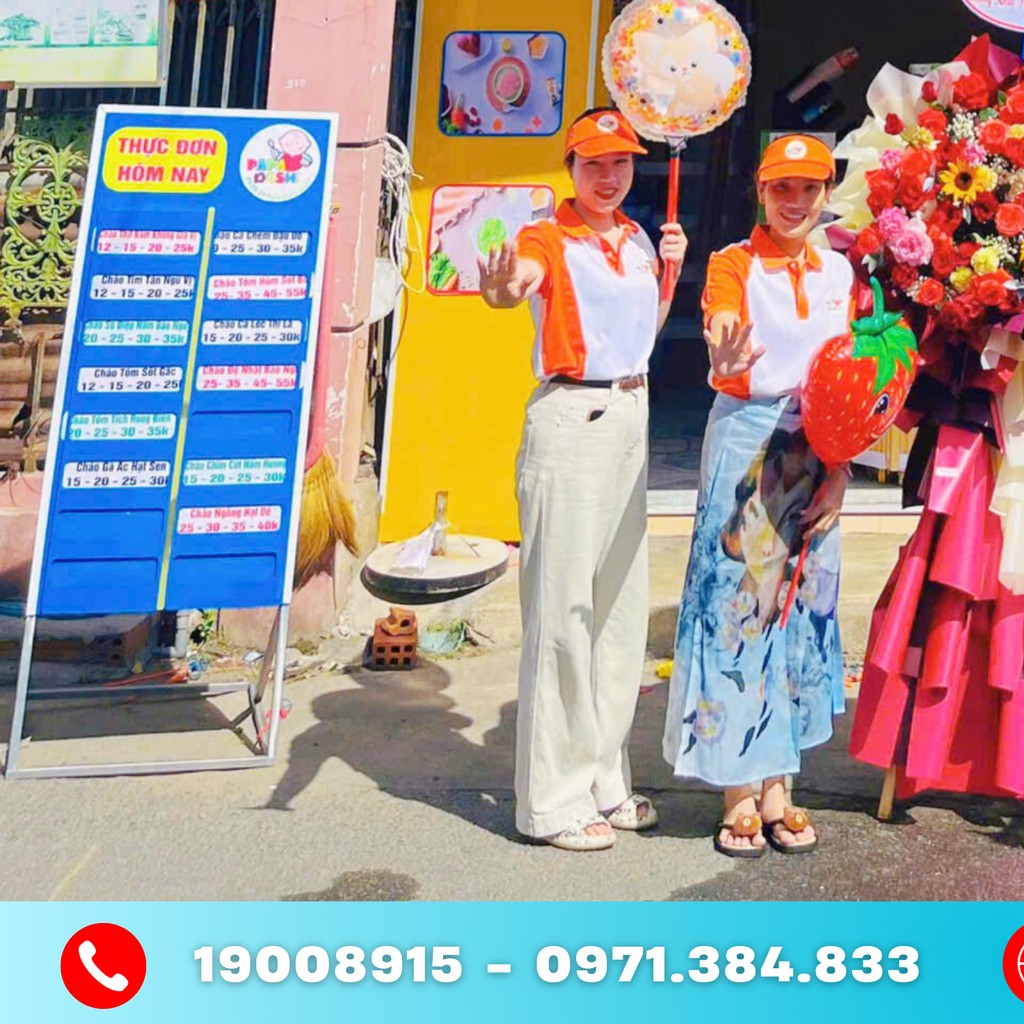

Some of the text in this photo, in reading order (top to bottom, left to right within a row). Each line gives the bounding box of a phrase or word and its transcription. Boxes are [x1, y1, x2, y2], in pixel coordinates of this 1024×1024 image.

[118, 136, 218, 158] THỰC ĐƠN
[117, 163, 211, 183] HÔM NAY
[94, 289, 162, 297] 12 15 20
[204, 333, 268, 342] 15 20 25
[82, 381, 151, 391] 12 15 20
[67, 476, 137, 486] 15 20 25
